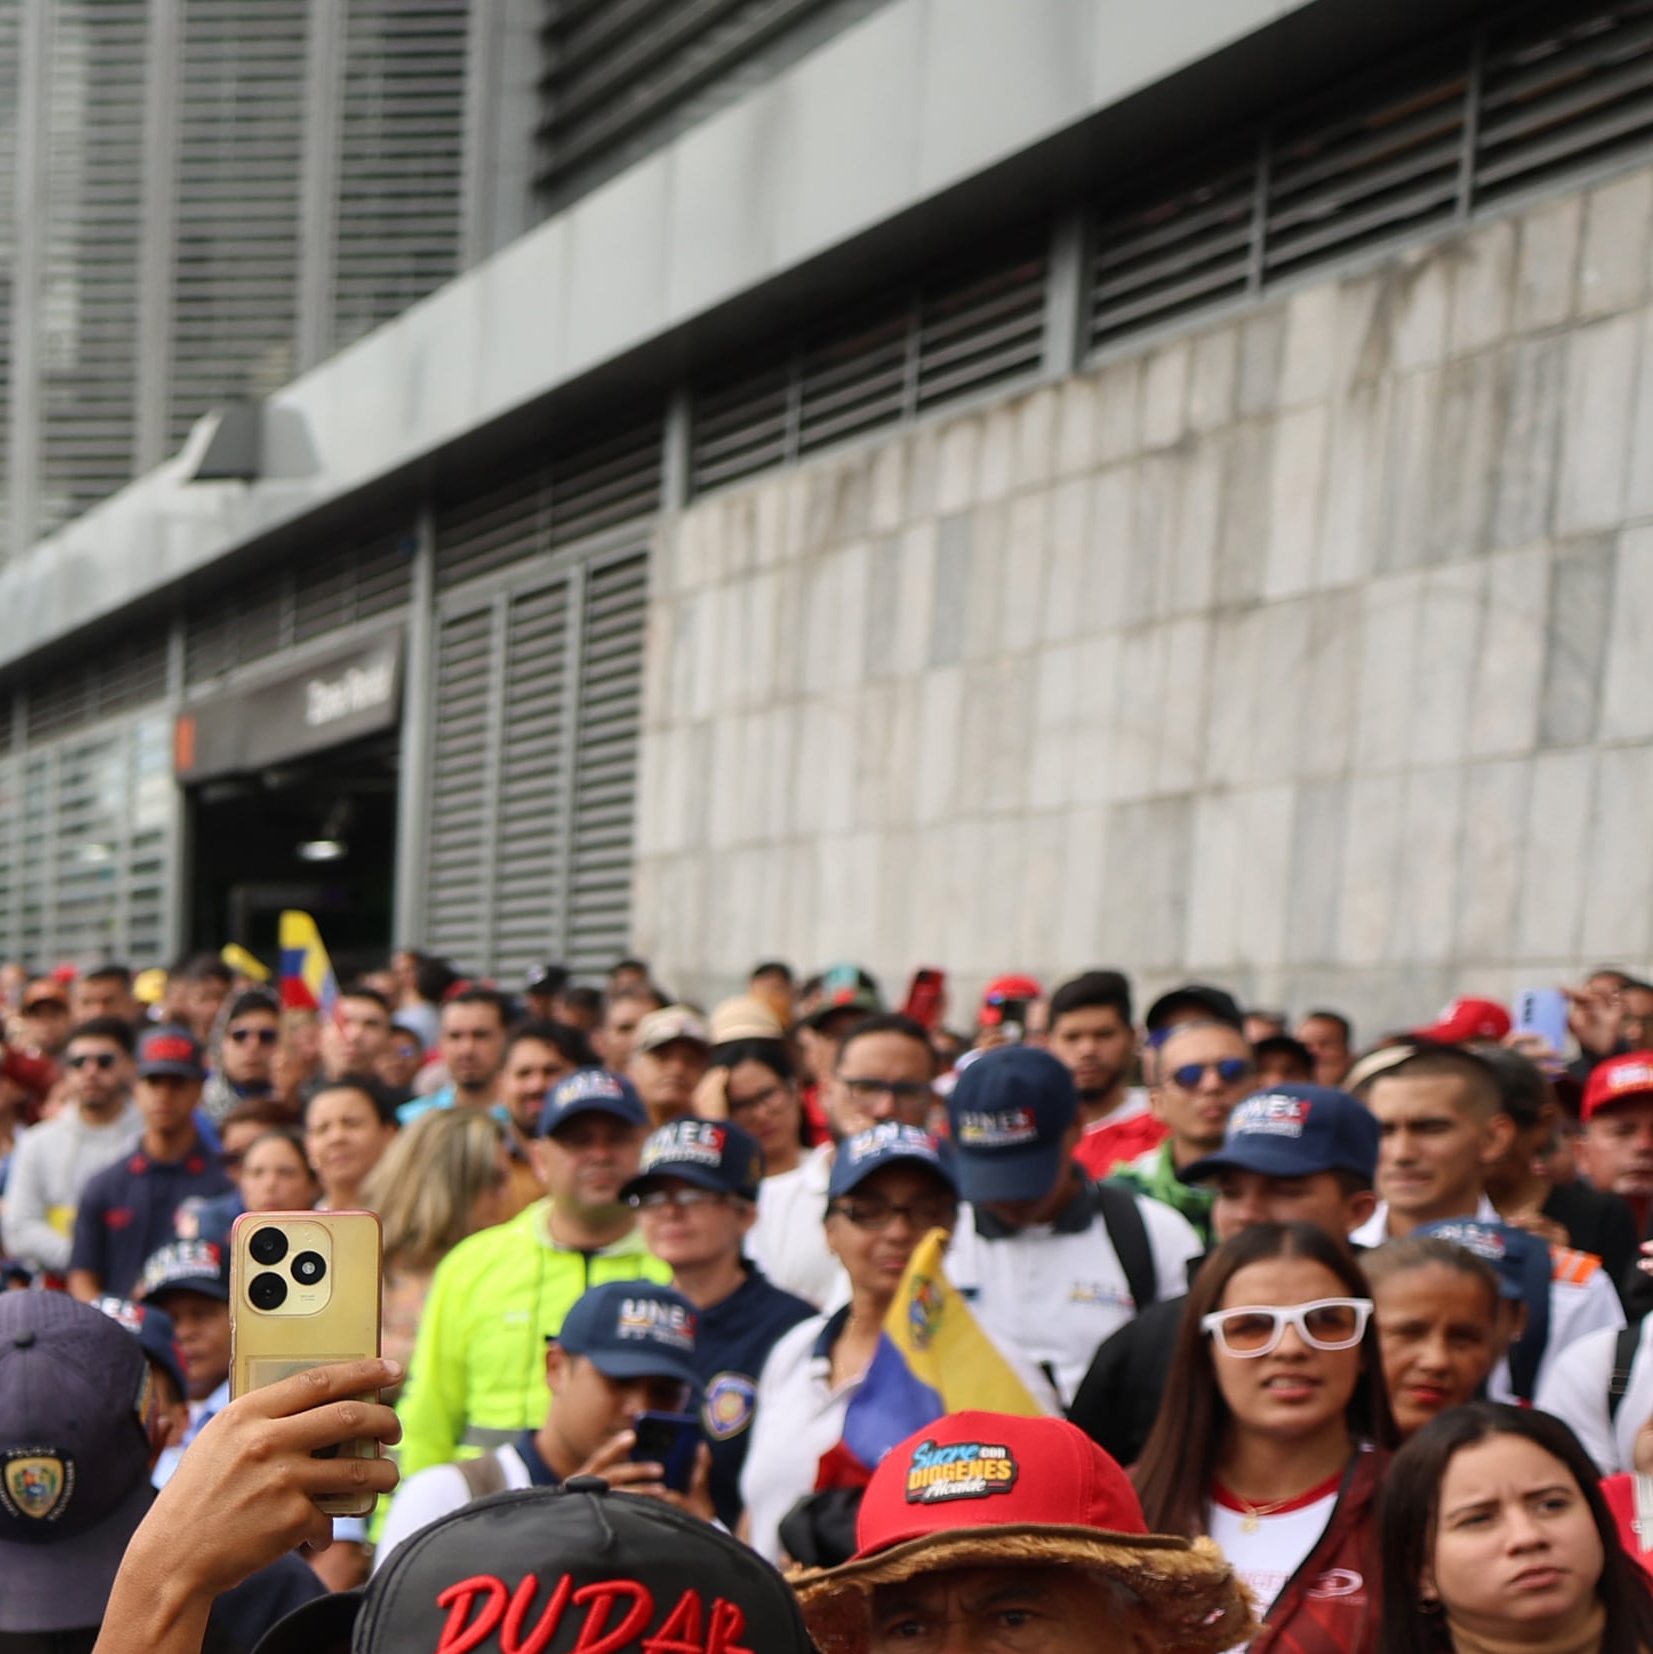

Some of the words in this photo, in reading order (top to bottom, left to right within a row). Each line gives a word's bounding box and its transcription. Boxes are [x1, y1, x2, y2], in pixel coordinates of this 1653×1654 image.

[910, 1442, 980, 1472] Sucre
[978, 1446, 1006, 1459] con
[907, 1459, 1013, 1490] DIOGENES
